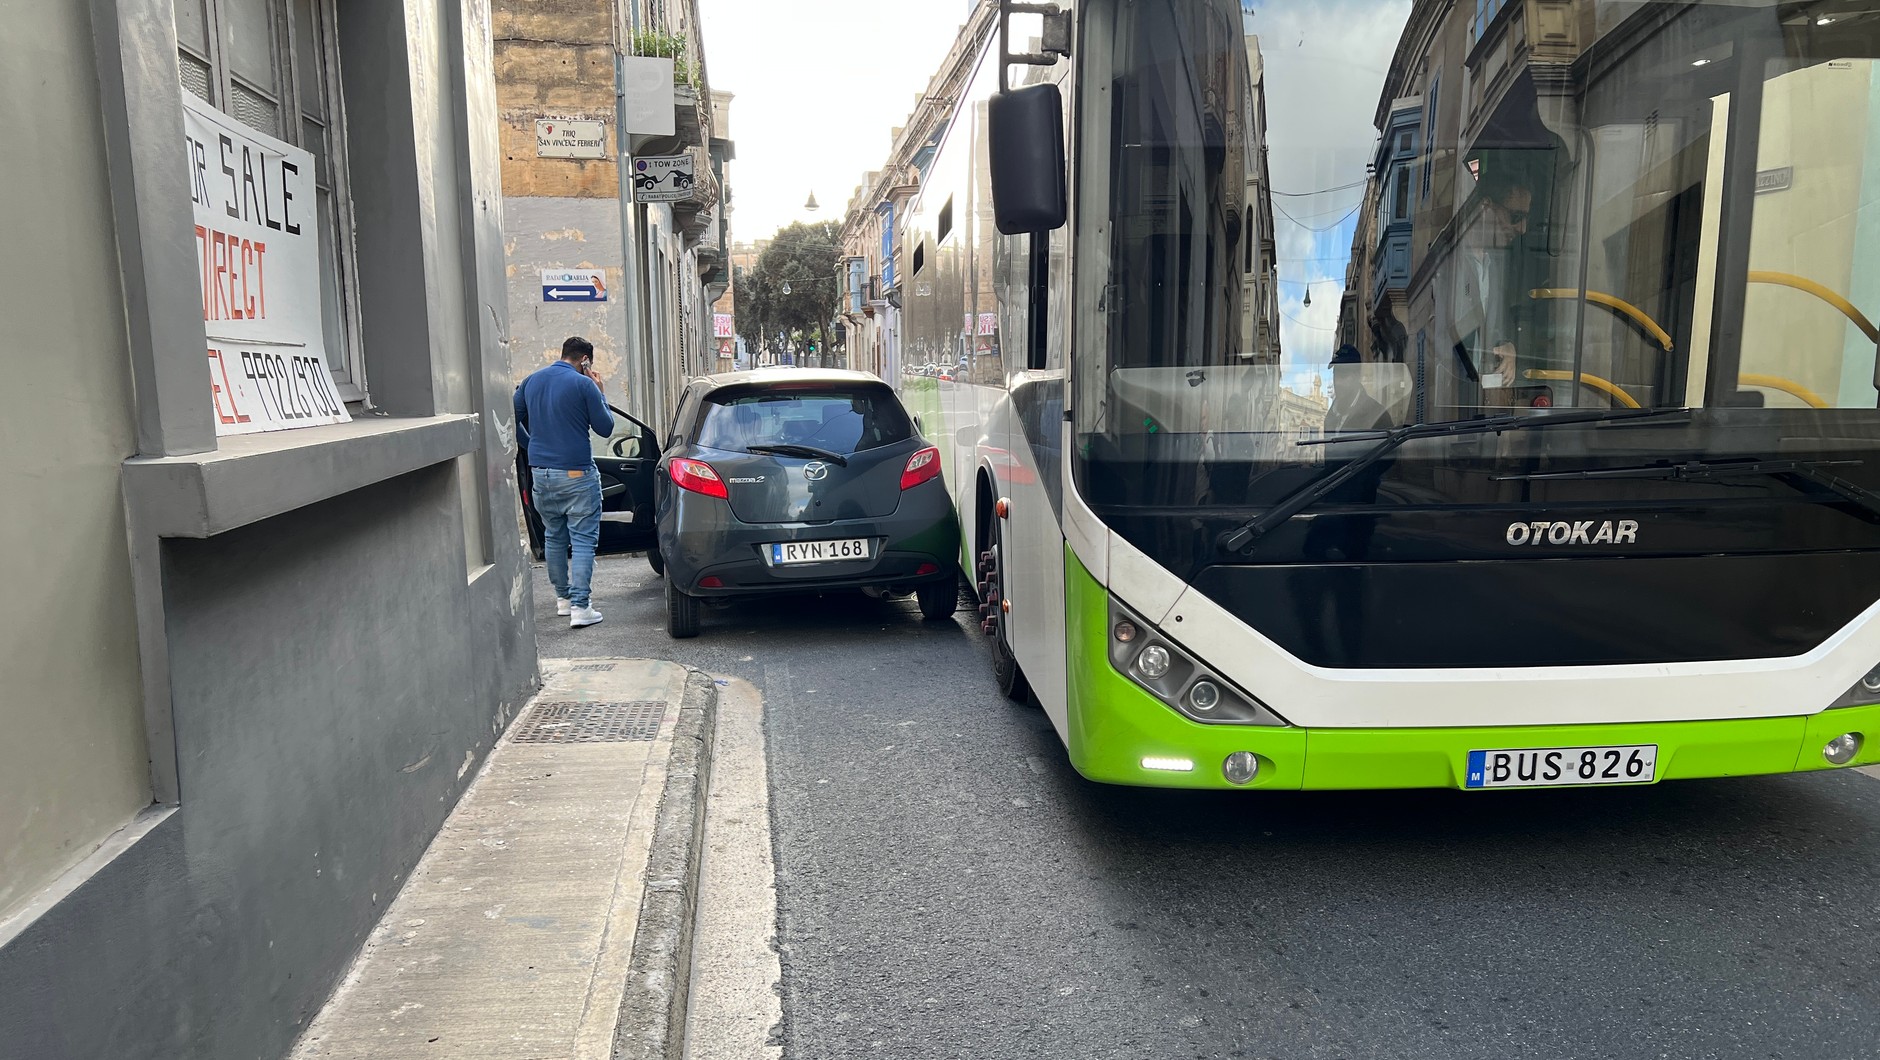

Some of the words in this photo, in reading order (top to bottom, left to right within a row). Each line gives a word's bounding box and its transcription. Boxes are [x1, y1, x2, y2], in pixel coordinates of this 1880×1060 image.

[562, 130, 576, 138] TRIQ
[219, 132, 300, 235] SALE
[195, 224, 266, 321] DIRECT
[241, 351, 341, 420] 99226930
[1506, 520, 1639, 546] OTOKAR
[787, 543, 822, 560] RYN
[828, 540, 862, 558] 168
[1471, 772, 1480, 780] M
[1492, 752, 1562, 782] BUS
[1578, 749, 1646, 780] 826
